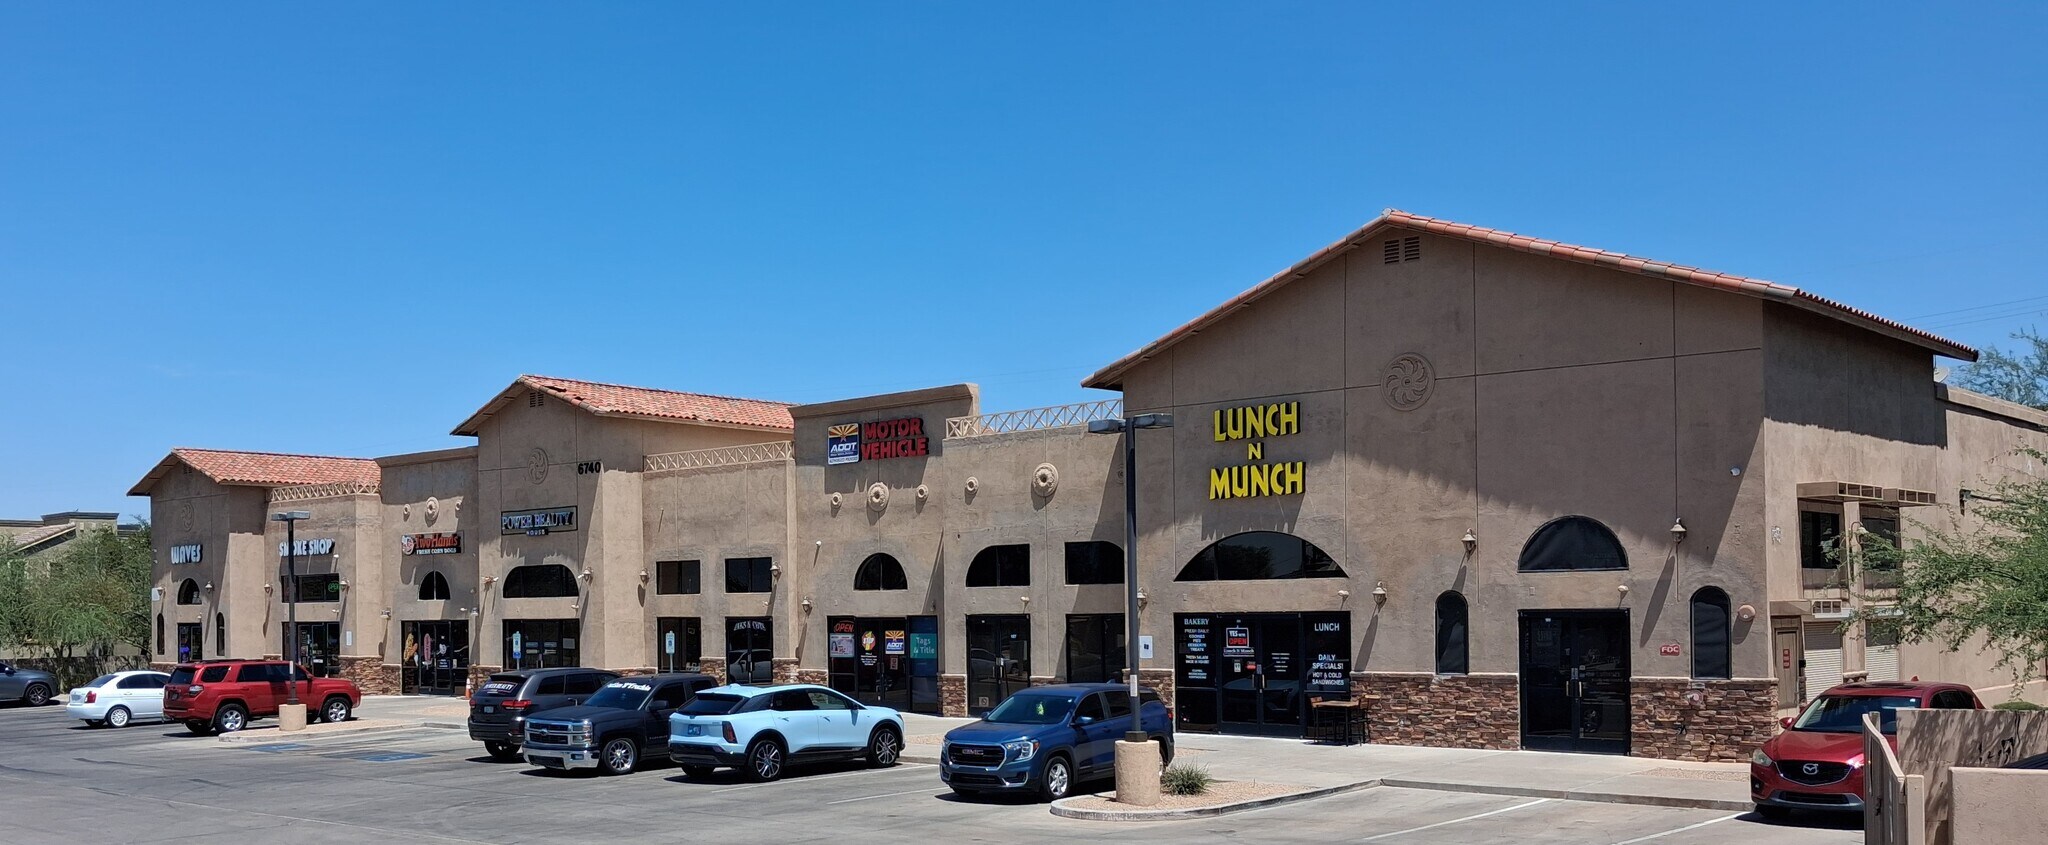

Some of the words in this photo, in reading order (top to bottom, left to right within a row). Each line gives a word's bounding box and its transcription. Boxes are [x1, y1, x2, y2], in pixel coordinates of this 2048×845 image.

[863, 418, 923, 439] MOTOR
[1214, 402, 1299, 441] LUNCH
[830, 442, 857, 453] ADOT
[861, 437, 928, 460] VEHICLE
[1248, 442, 1262, 460] N
[578, 462, 601, 475] 6740
[1209, 461, 1305, 500] MUNCH
[502, 514, 533, 529] POWER
[534, 511, 573, 527] BEAUTY
[308, 538, 334, 556] SHOP
[415, 534, 431, 549] Two
[431, 533, 459, 548] Hands
[171, 544, 202, 564] WAVES
[834, 622, 854, 633] OPEN
[1314, 623, 1340, 631] LUNCH
[916, 637, 931, 646] Tags
[1661, 645, 1679, 653] FDC
